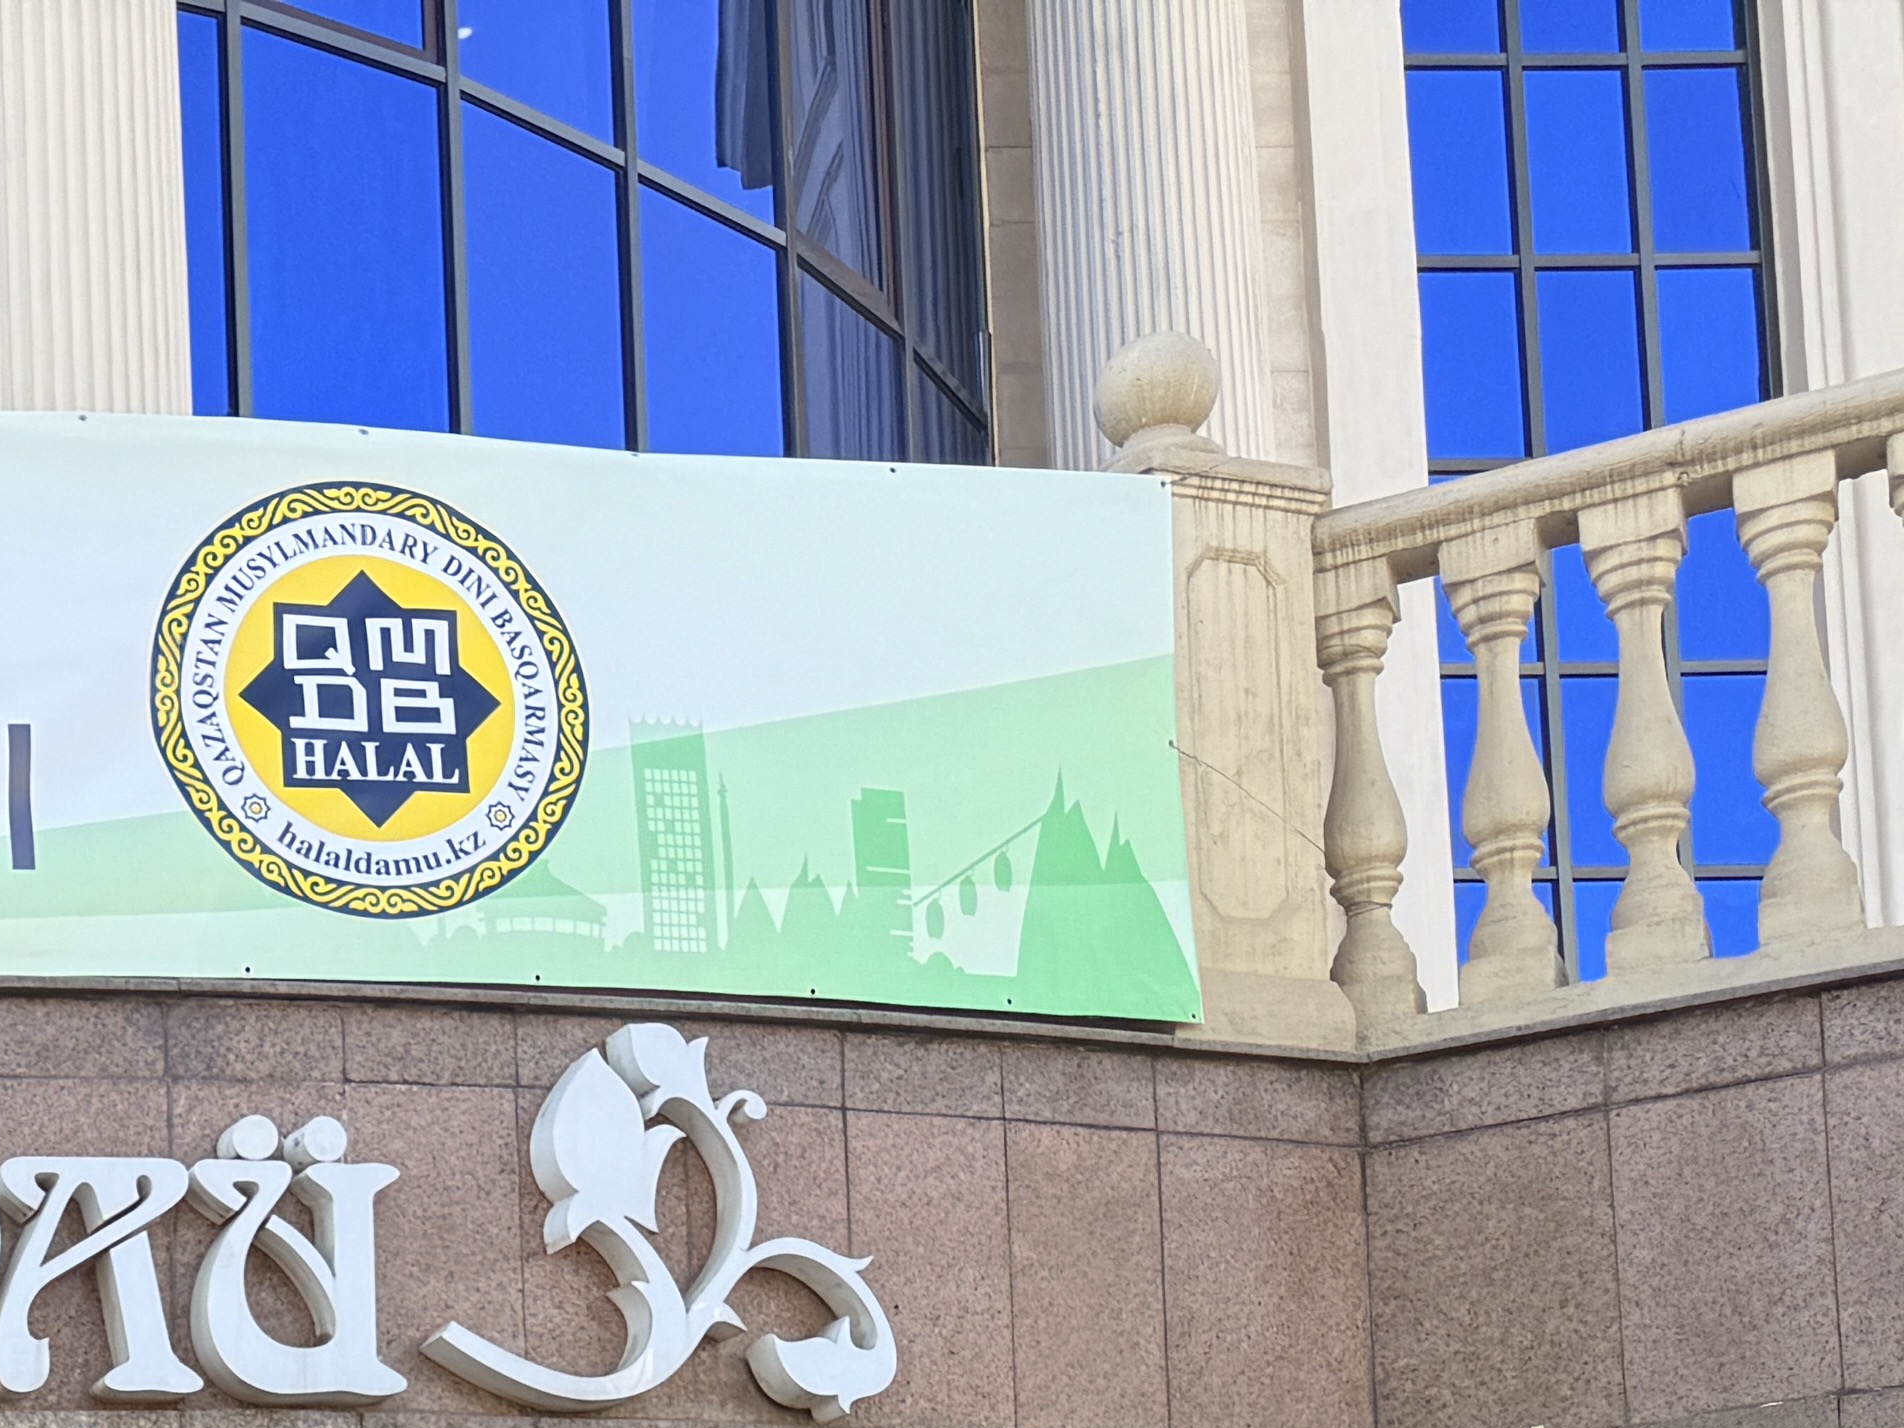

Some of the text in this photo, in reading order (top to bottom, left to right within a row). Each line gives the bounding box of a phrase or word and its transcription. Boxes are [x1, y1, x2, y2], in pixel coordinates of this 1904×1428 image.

[192, 522, 548, 804] QAZAQSTAN MUSYLMANDARY DINI BASQARMASY
[290, 737, 460, 785] HALAL
[275, 819, 488, 877] halaldamu.kz
